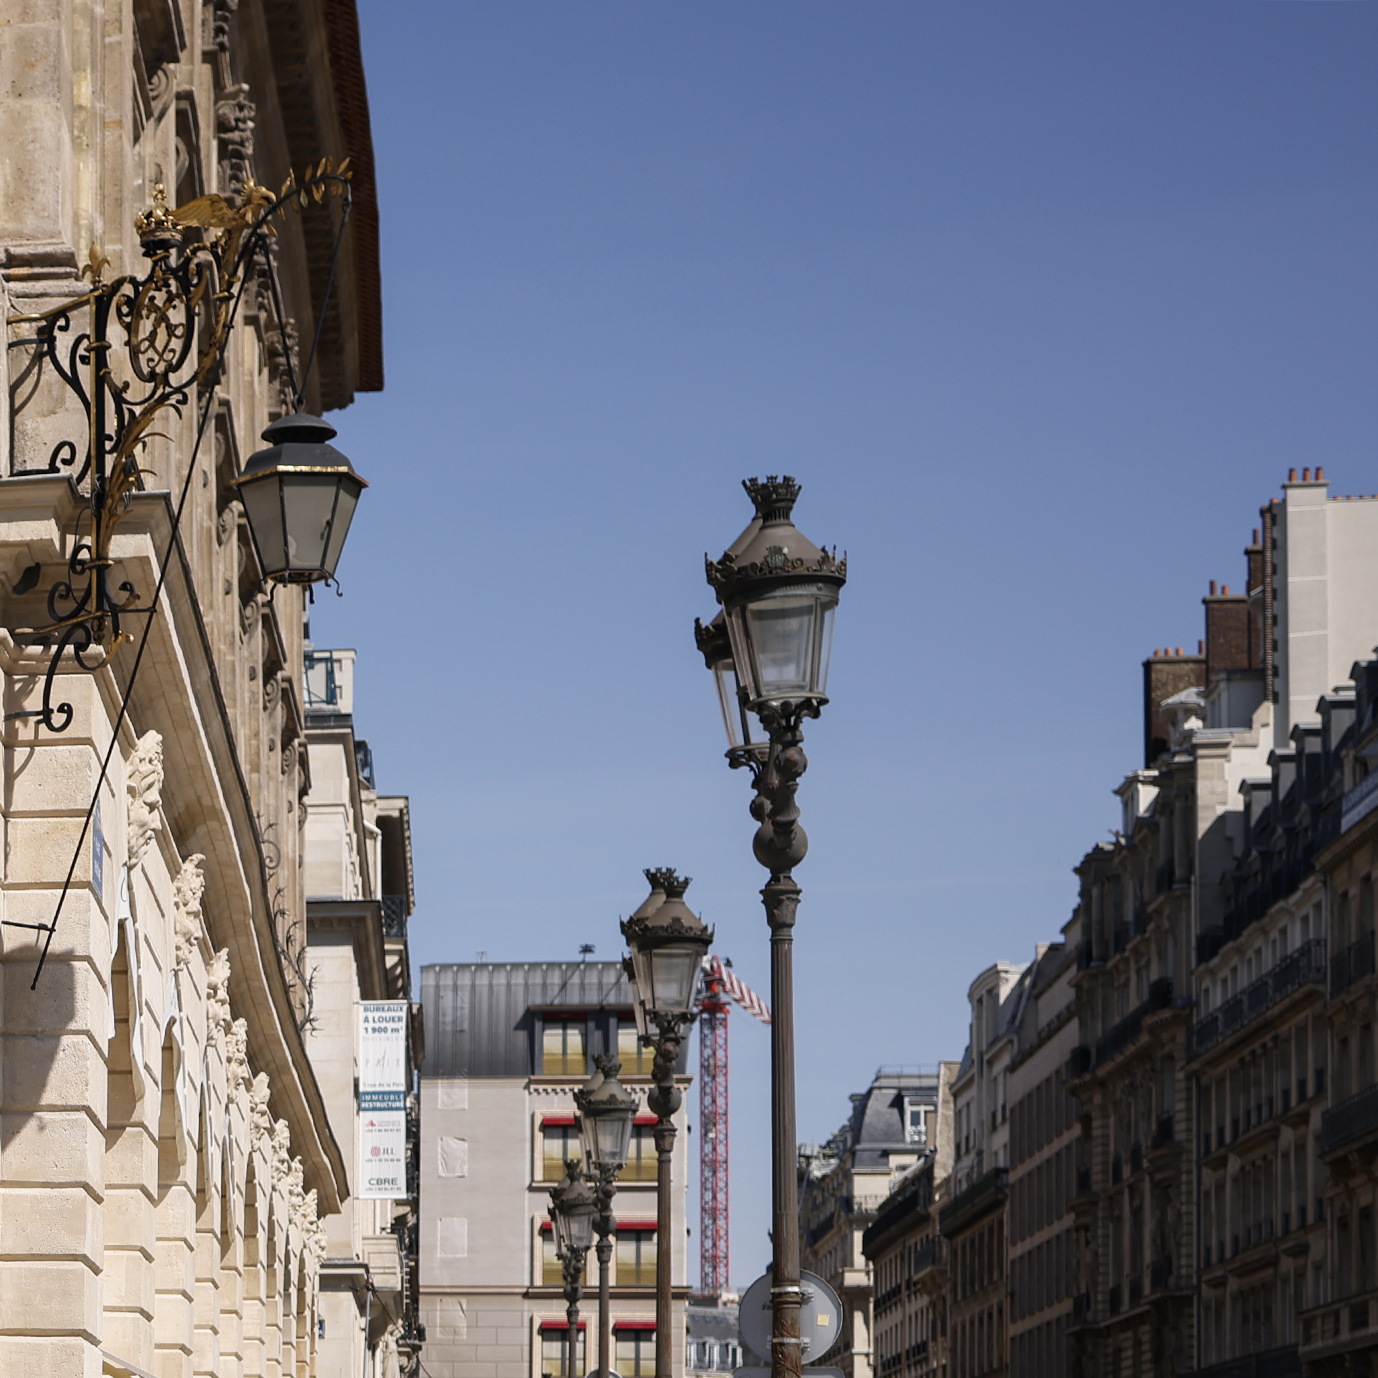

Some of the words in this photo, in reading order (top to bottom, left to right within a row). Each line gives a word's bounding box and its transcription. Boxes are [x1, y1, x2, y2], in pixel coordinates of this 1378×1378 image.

[372, 1015, 404, 1023] LOUER
[371, 1026, 388, 1034] 900
[368, 1177, 398, 1186] CBRE
